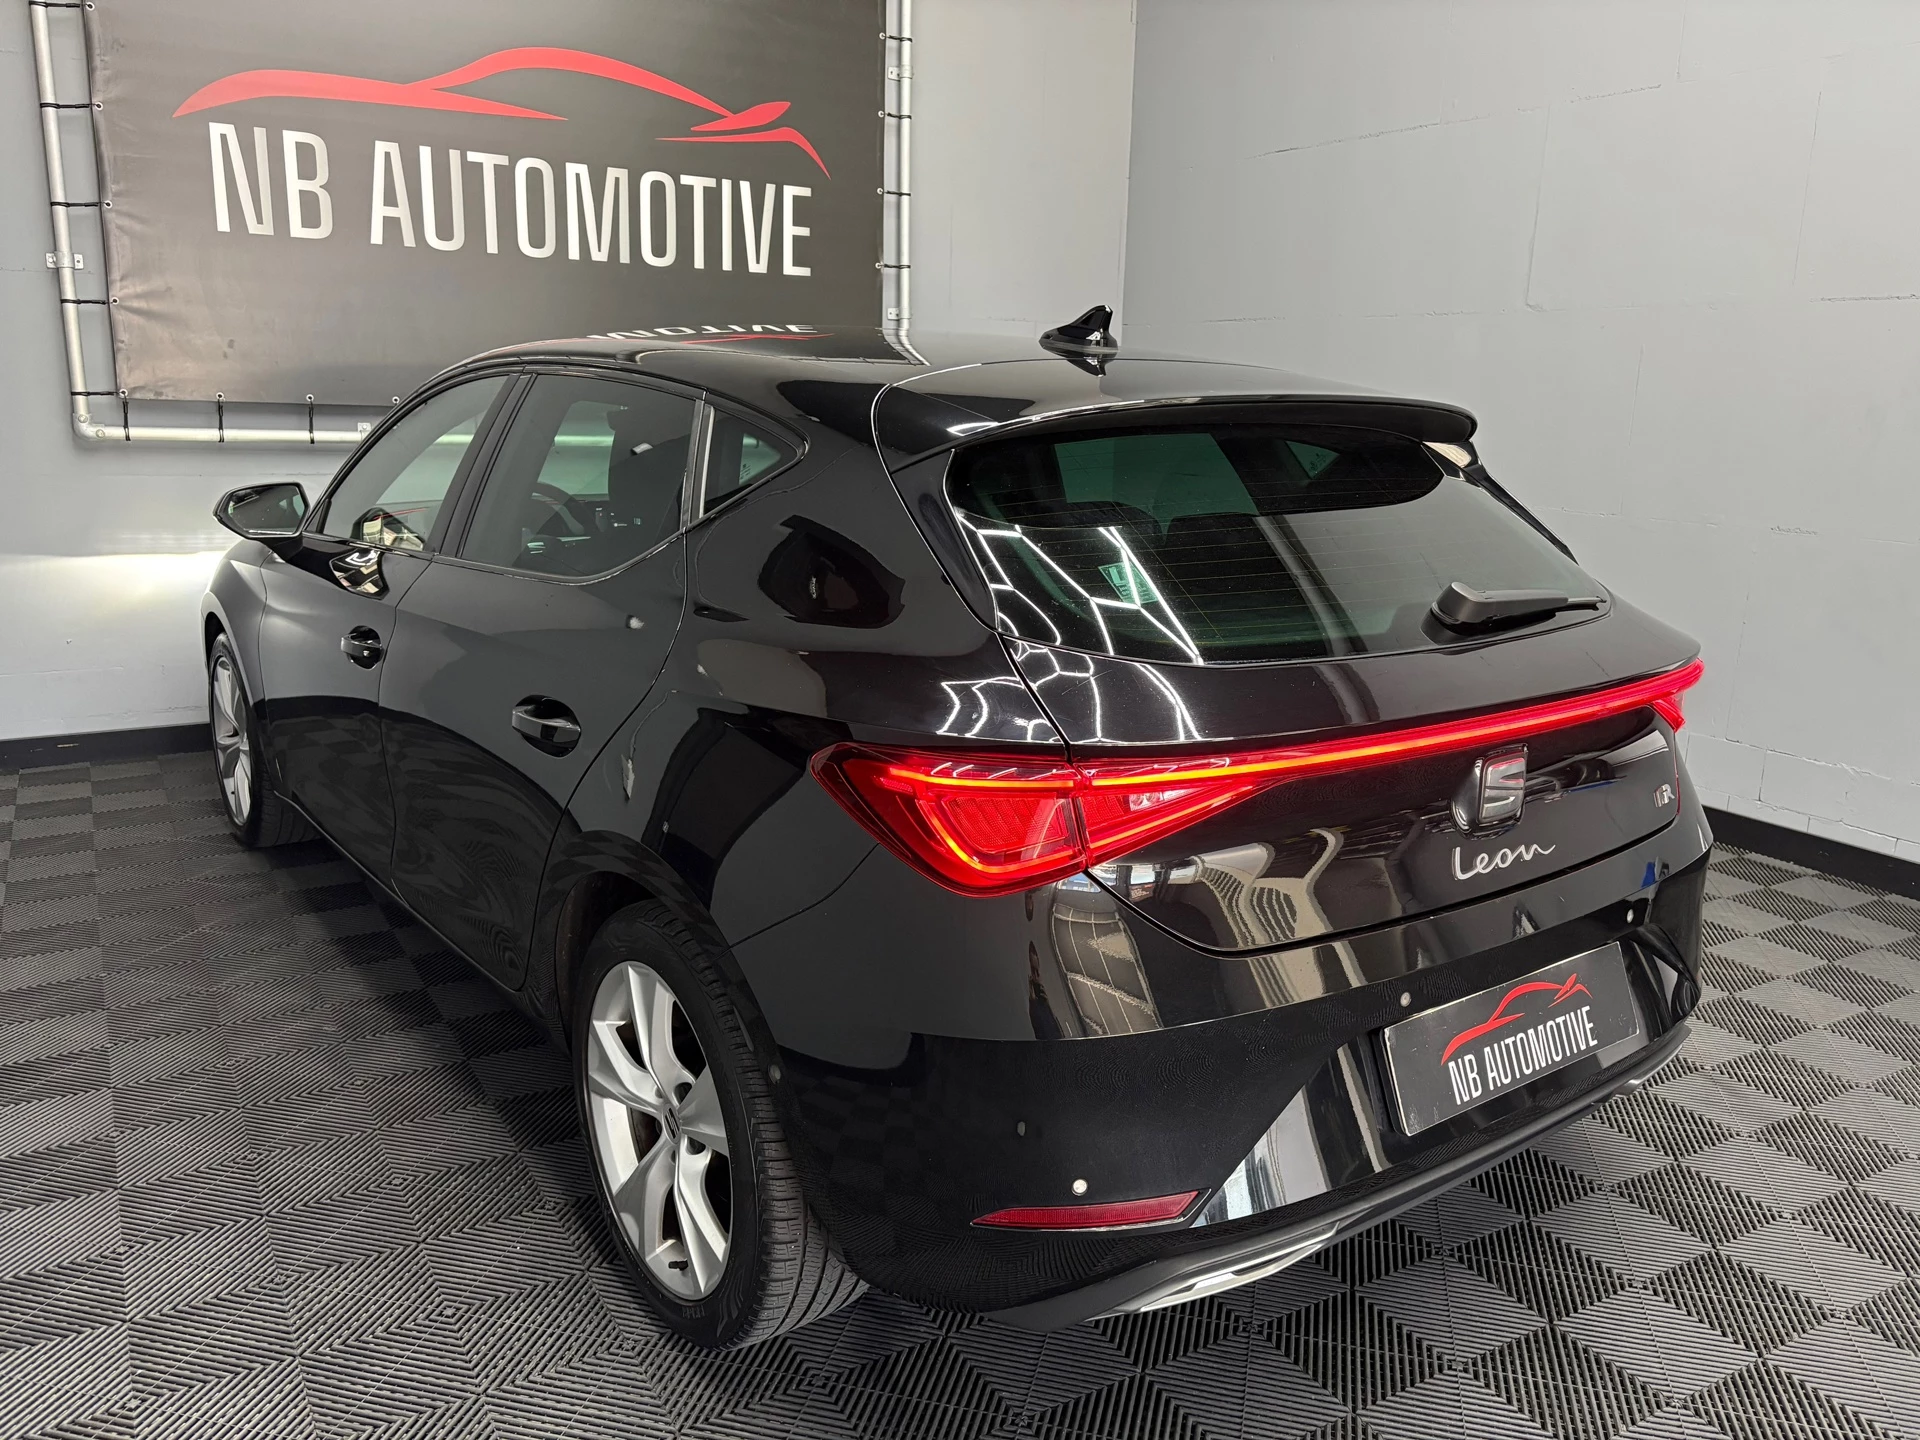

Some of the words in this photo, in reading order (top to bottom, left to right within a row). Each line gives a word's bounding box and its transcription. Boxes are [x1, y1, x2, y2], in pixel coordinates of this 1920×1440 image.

[208, 121, 333, 240] NB
[369, 139, 812, 277] AUTOMOTIVE
[1452, 843, 1555, 880] Leon
[1448, 1053, 1483, 1105] NB
[1484, 1005, 1597, 1090] AUTOMOTIVE
